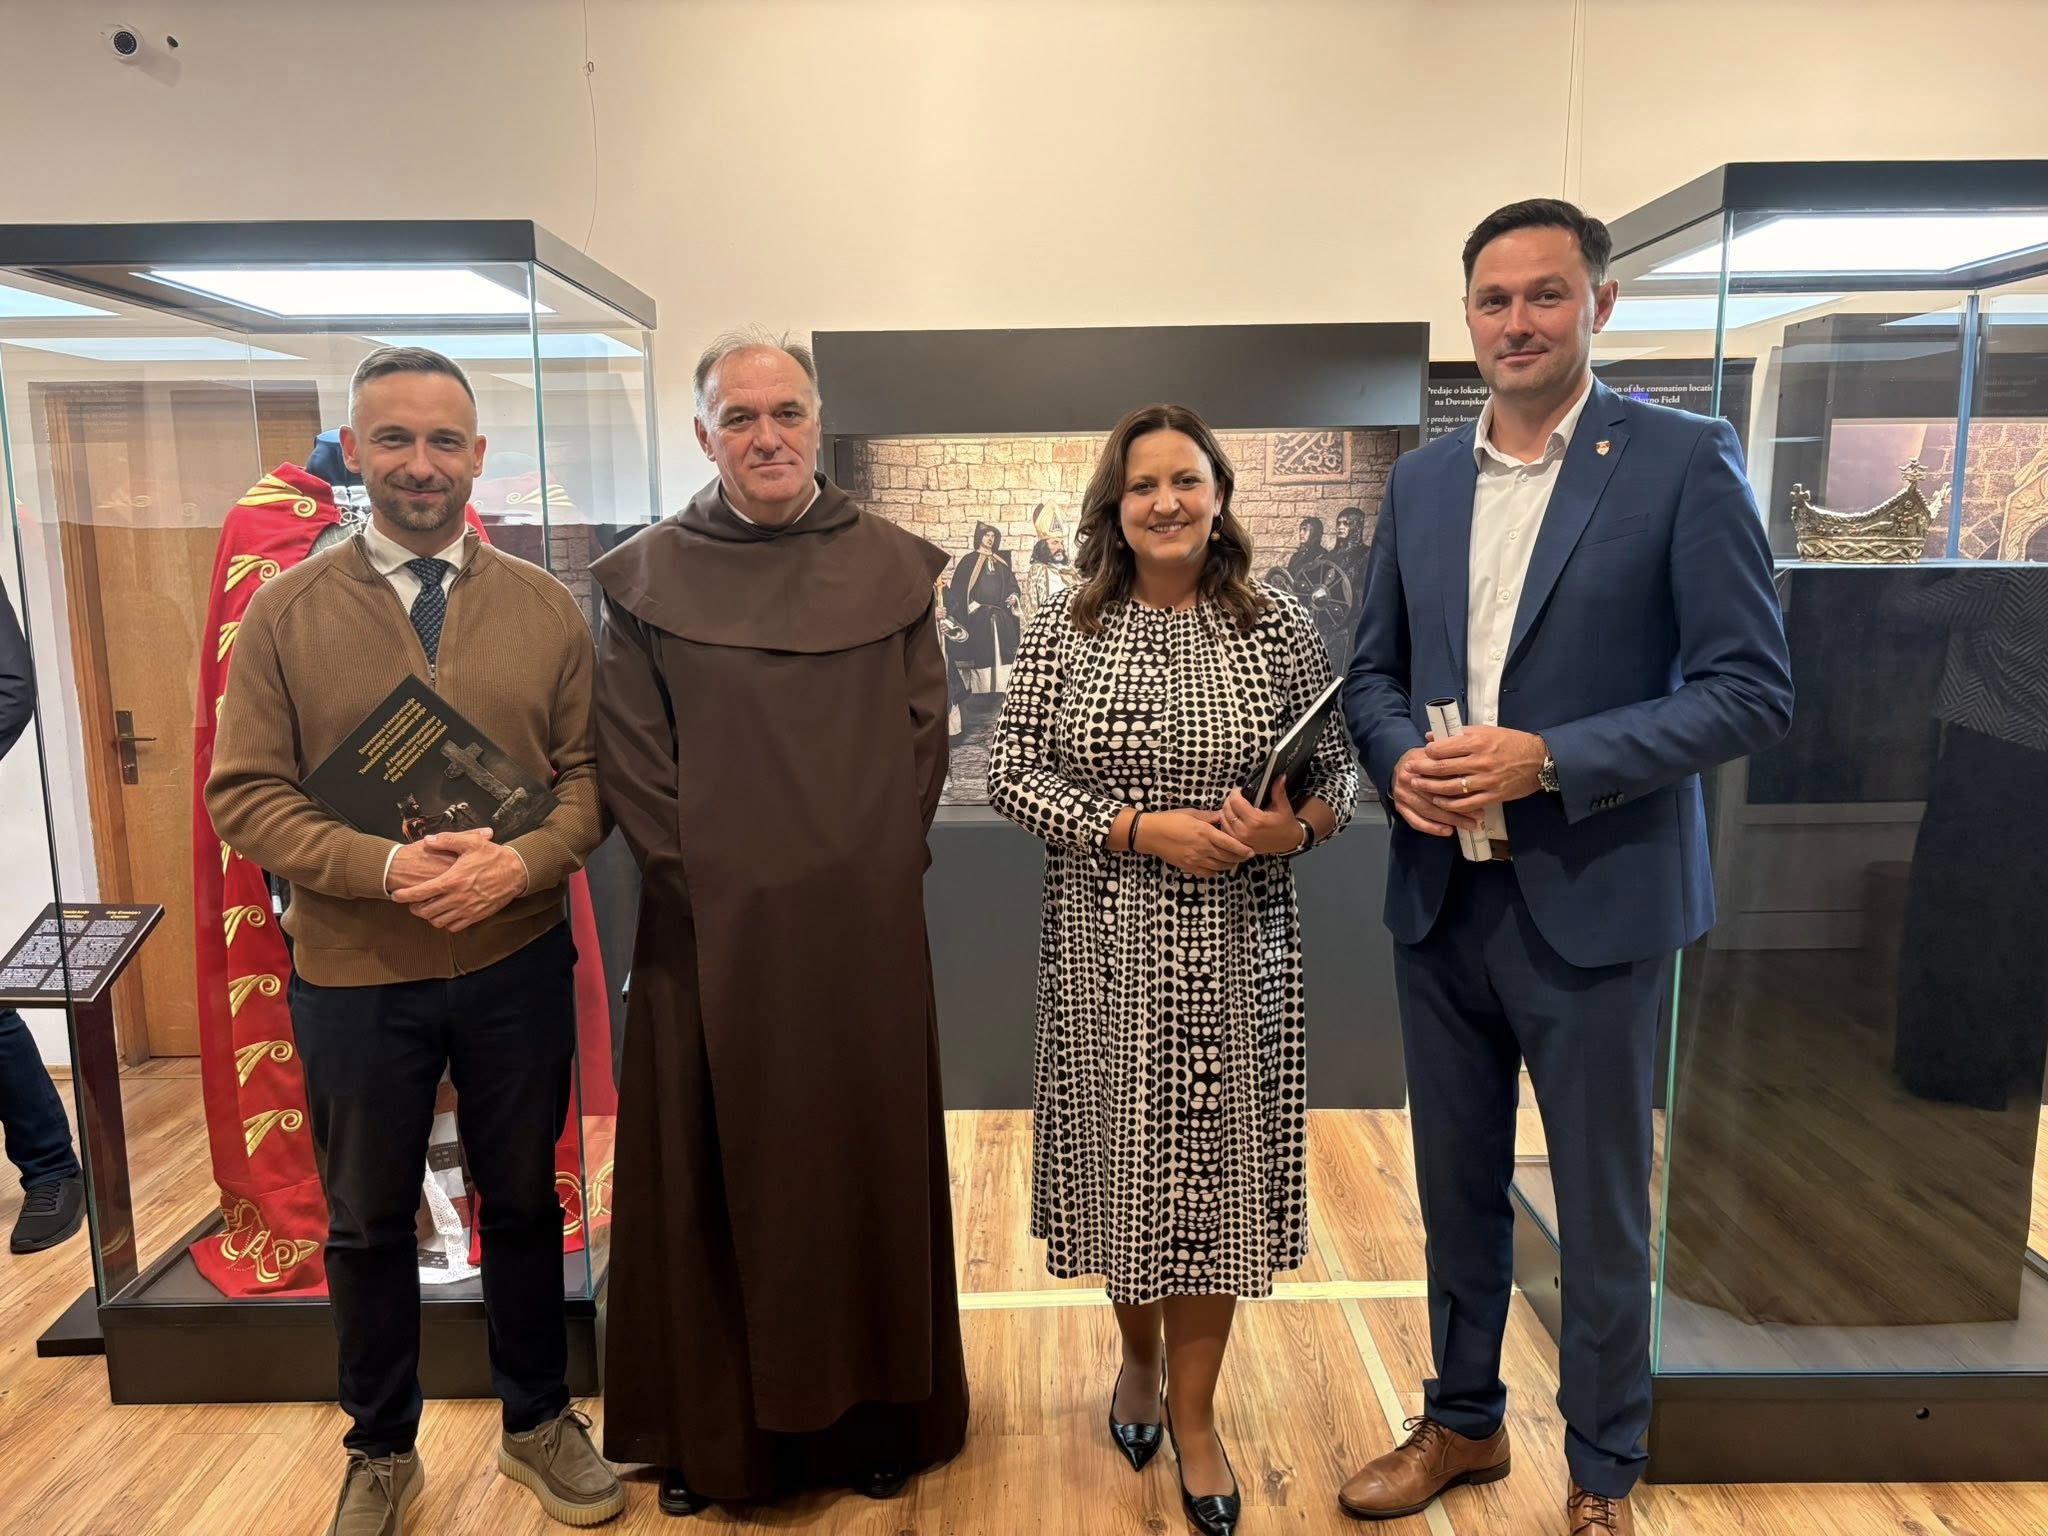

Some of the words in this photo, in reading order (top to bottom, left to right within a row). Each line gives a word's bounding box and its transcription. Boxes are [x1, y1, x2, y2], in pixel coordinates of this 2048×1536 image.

[1460, 386, 1488, 396] lokaciji
[1623, 384, 1633, 393] of
[1633, 384, 1646, 393] the
[1647, 384, 1688, 393] coronation
[1660, 395, 1681, 404] Field
[1430, 415, 1454, 424] predaje
[359, 728, 385, 754] Suvremena
[389, 766, 397, 774] the
[396, 745, 417, 766] Historical
[417, 726, 436, 745] Tradition
[390, 746, 406, 762] Modern
[405, 715, 437, 747] Interpretation
[359, 751, 382, 774] Tomislava
[391, 771, 403, 783] King
[423, 724, 448, 749] Coronation
